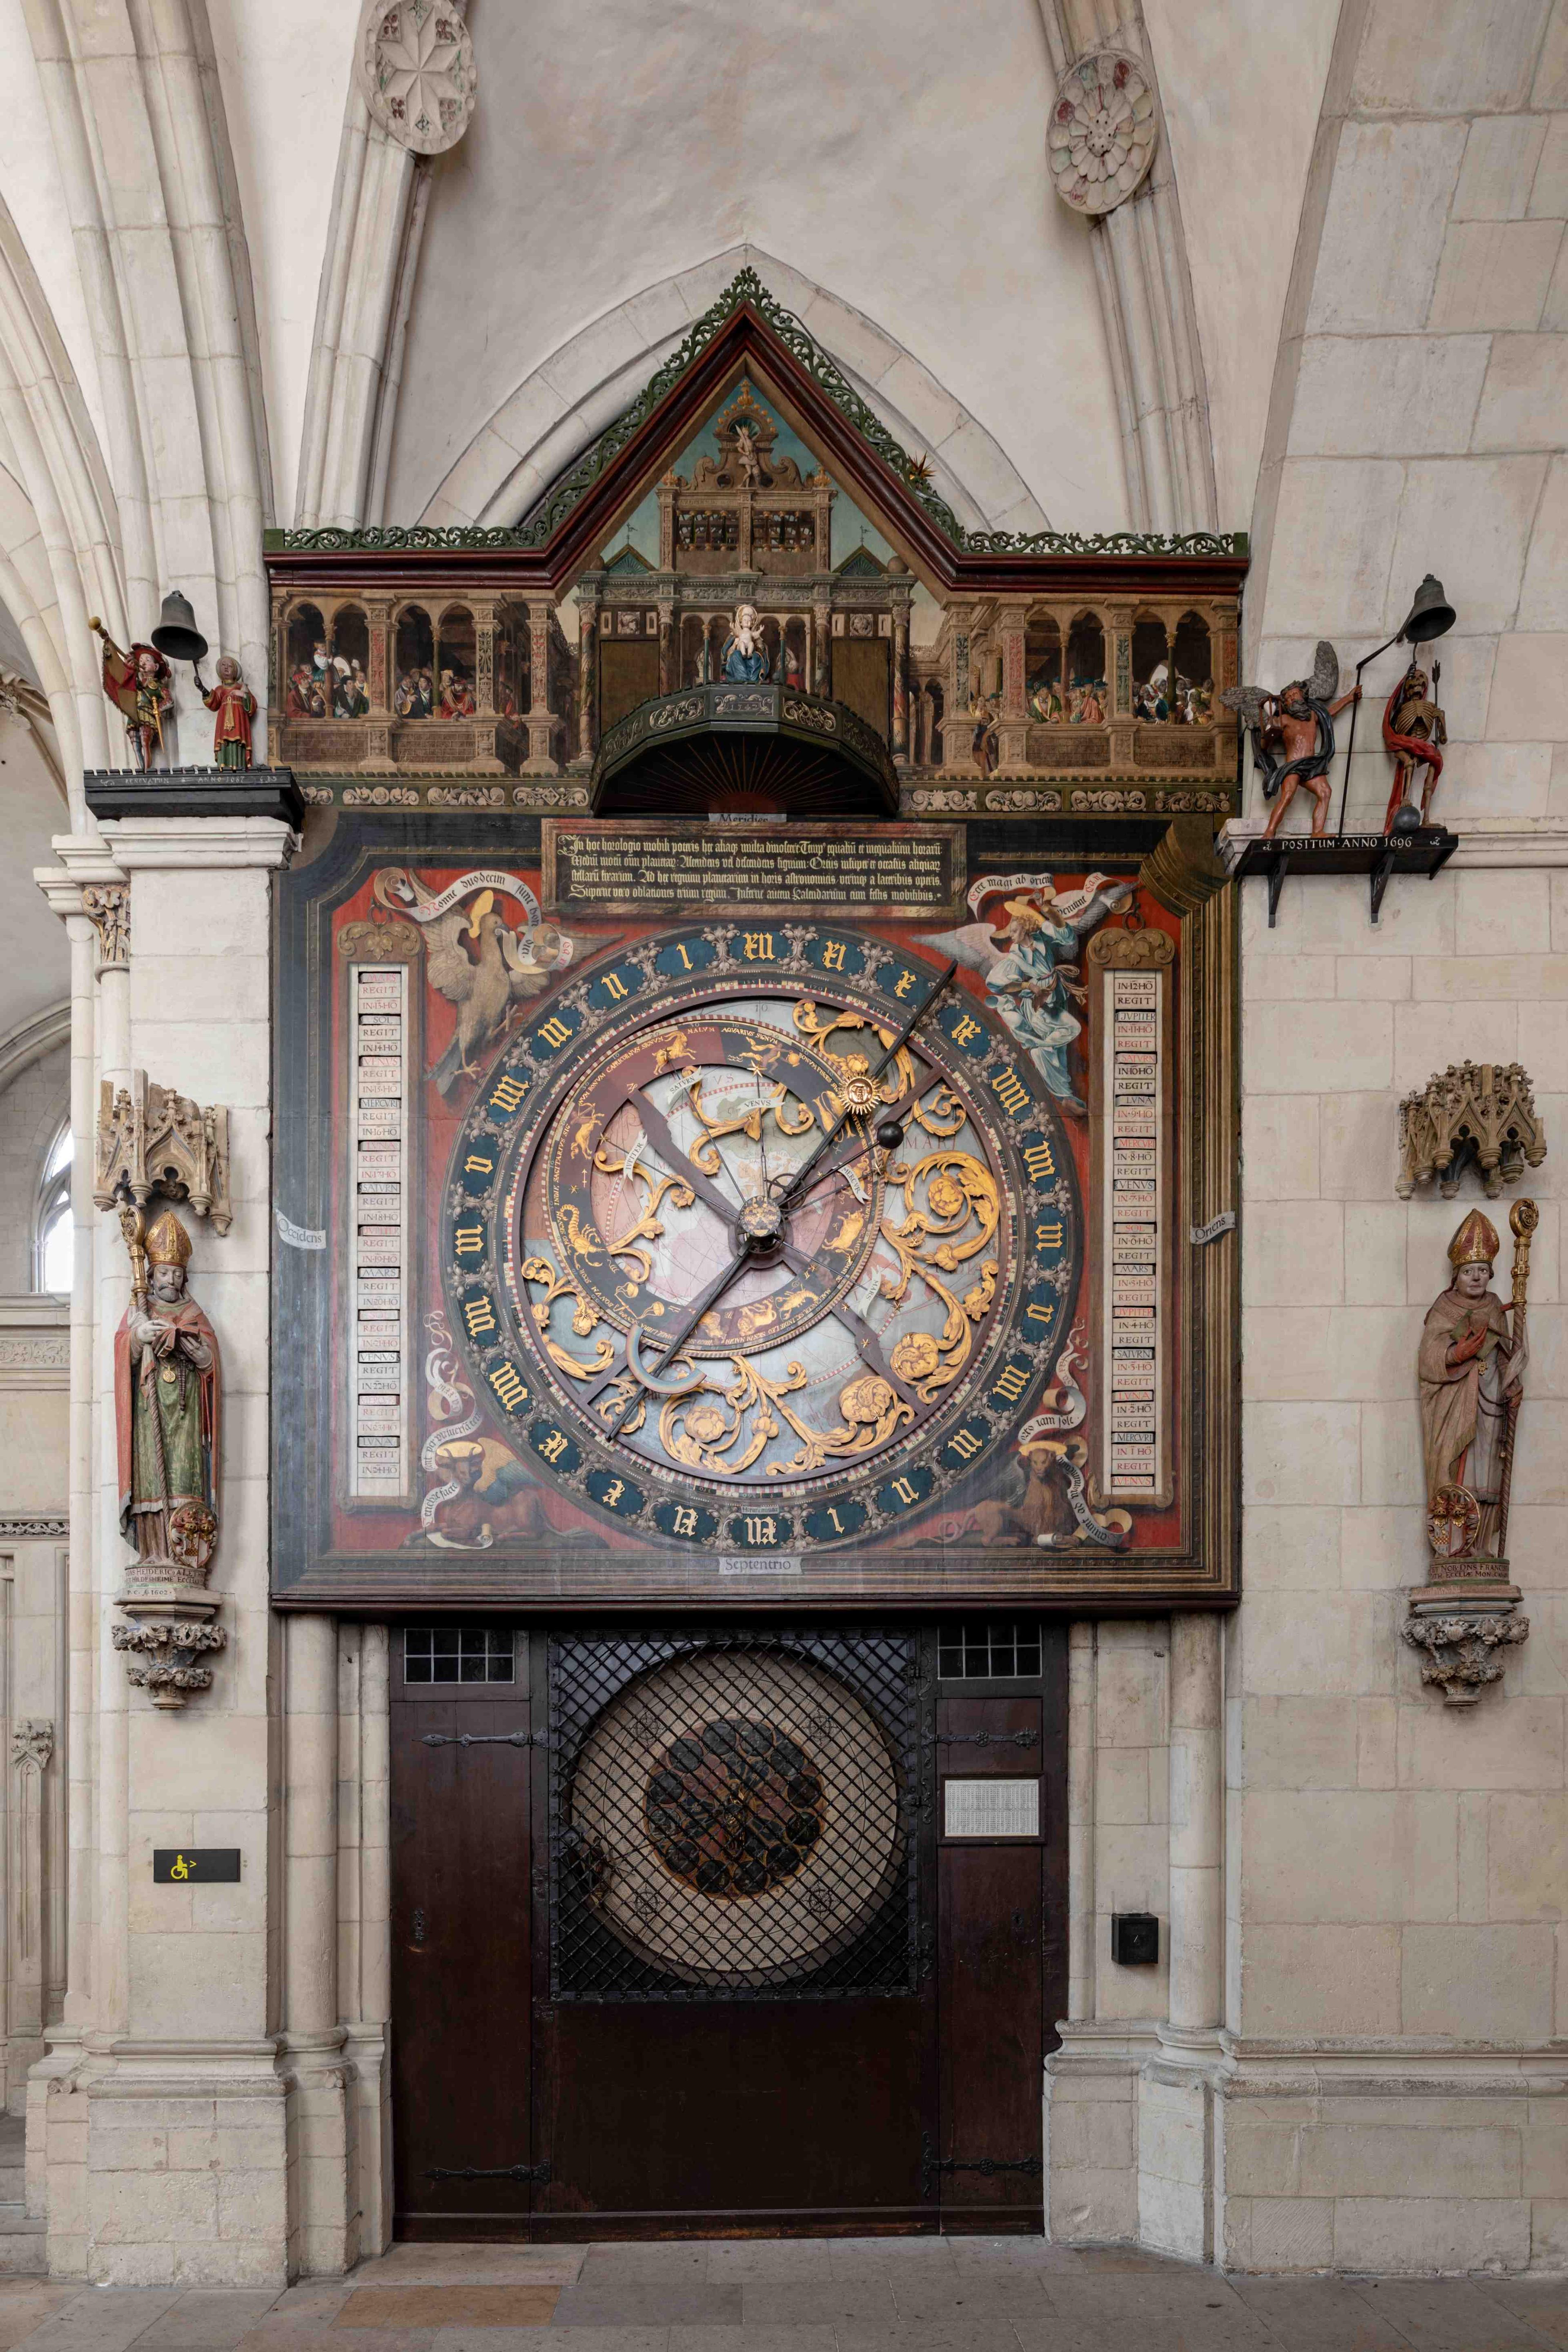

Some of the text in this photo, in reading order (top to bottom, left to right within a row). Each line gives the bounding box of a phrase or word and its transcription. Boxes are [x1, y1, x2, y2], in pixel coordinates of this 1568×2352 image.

[1281, 837, 1412, 850] POSITUM ANNO 1696
[669, 1076, 695, 1094] SATVRN
[278, 1218, 323, 1244] Occidens
[1195, 1217, 1227, 1238] Oriens
[865, 1280, 880, 1300] MARS
[360, 1353, 395, 1361] VENVS
[1119, 1392, 1150, 1400] LVNA
[363, 1438, 393, 1446] LVNA
[725, 1559, 791, 1572] Septentrio
